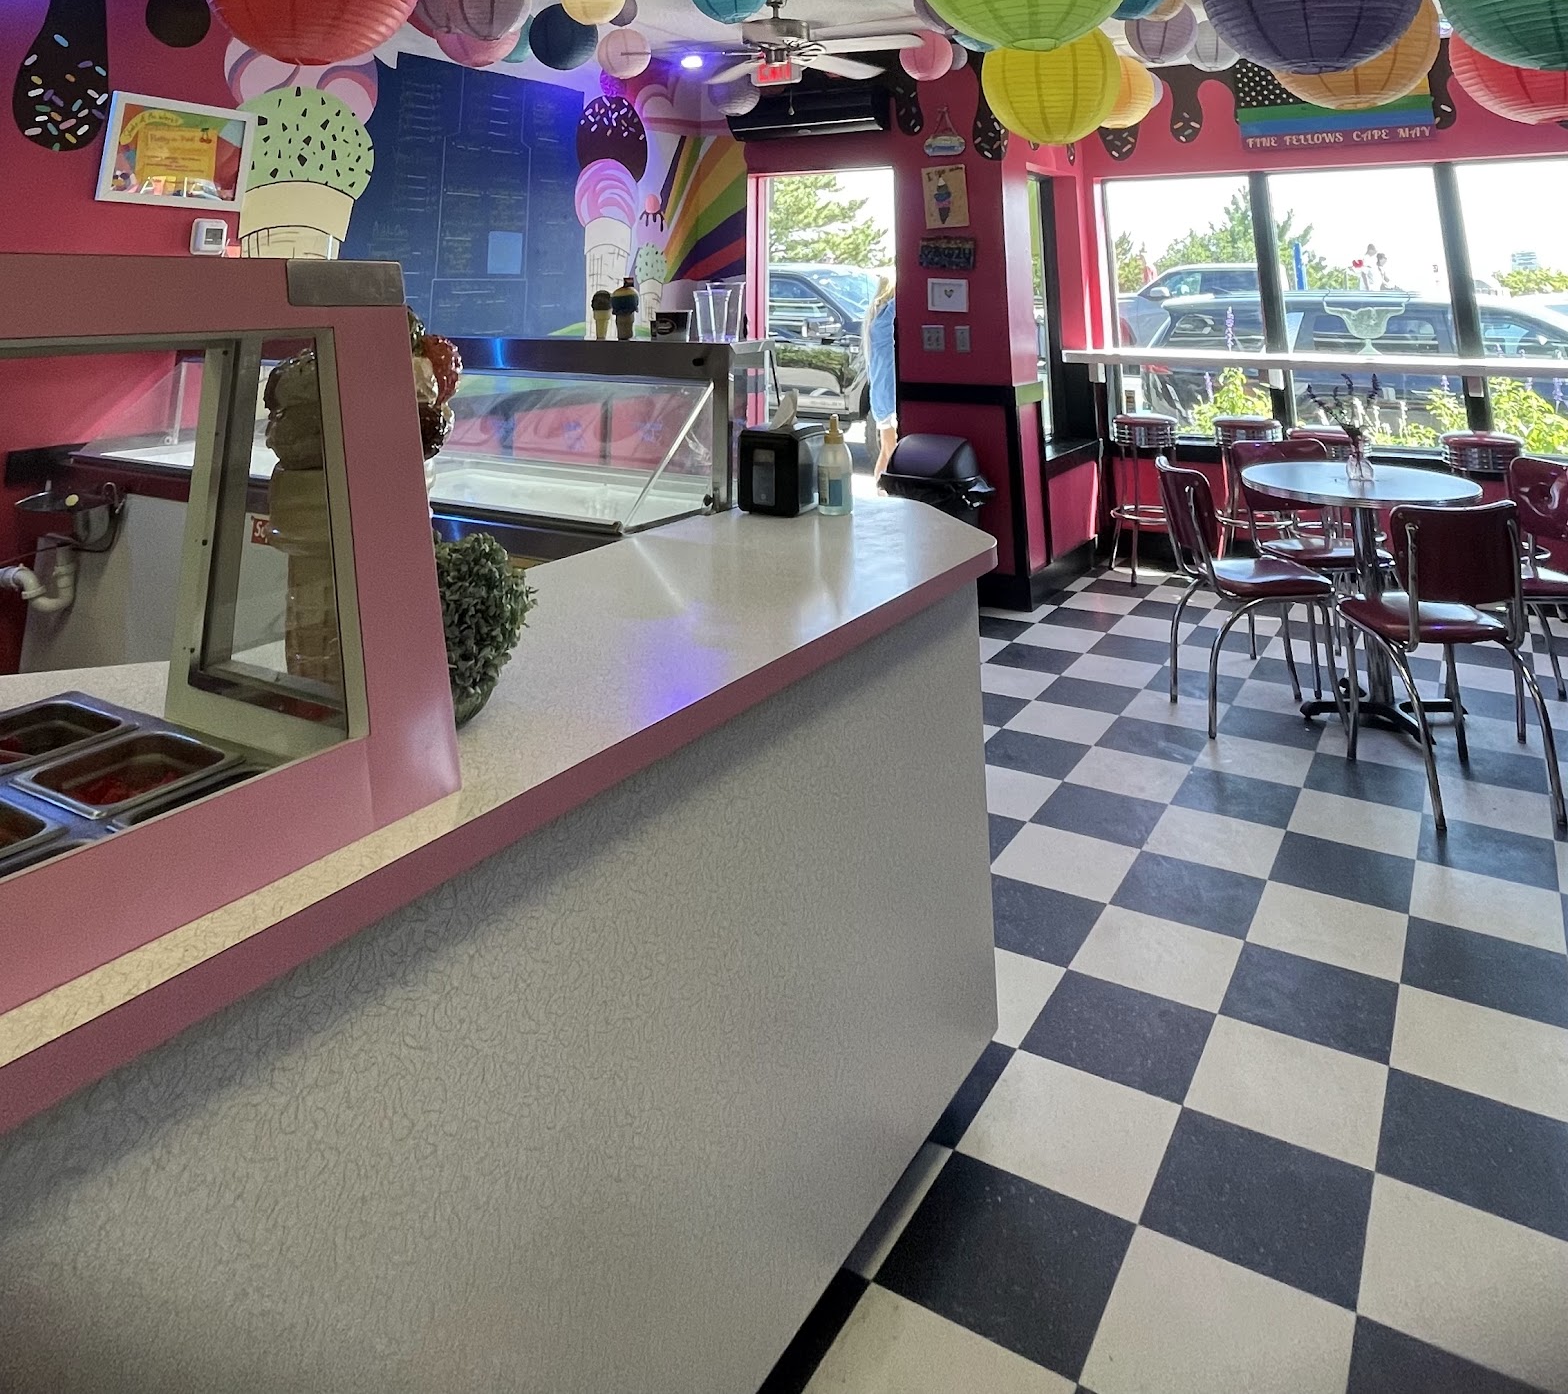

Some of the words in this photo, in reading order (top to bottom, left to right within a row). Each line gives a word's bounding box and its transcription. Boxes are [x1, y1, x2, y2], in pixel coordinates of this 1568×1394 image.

[1246, 136, 1278, 149] FINE
[1284, 132, 1344, 146] FELLOWS
[1352, 129, 1390, 142] CAPE
[1397, 126, 1431, 138] MAY
